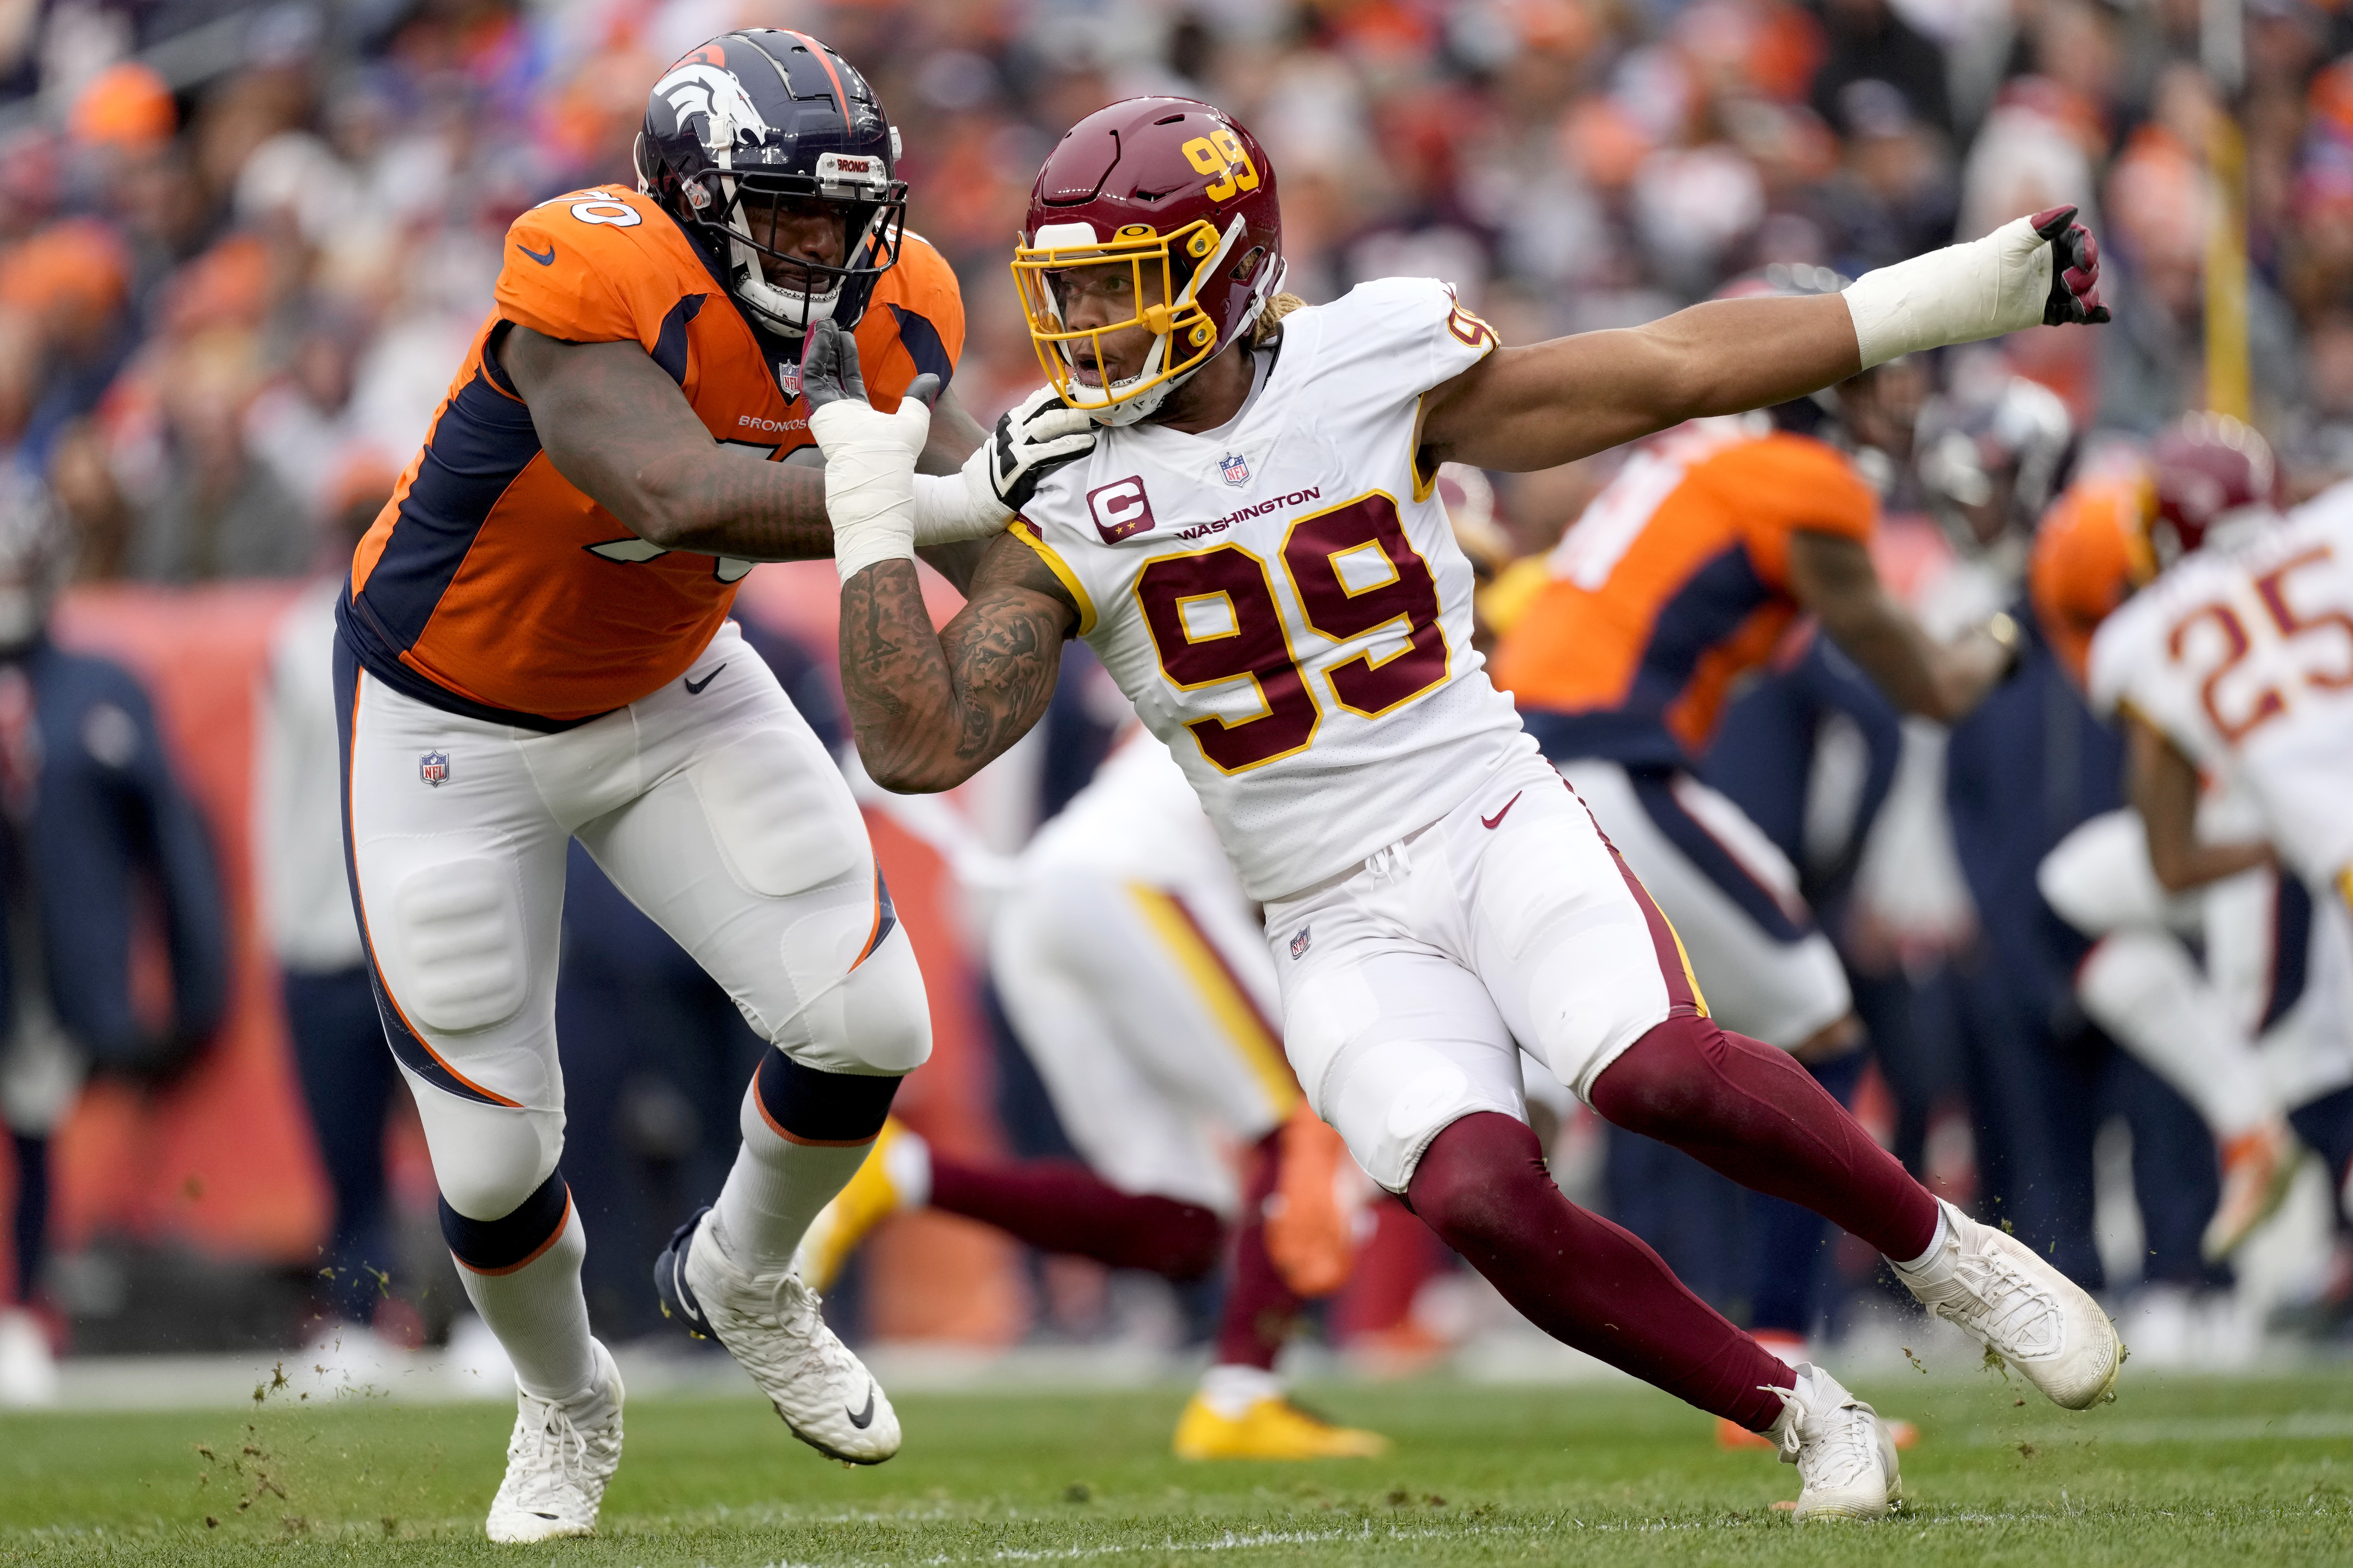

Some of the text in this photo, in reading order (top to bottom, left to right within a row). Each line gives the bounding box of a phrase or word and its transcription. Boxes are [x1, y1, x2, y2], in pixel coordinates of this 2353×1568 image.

[837, 159, 870, 173] BRONCOS
[1182, 130, 1259, 202] 99
[738, 415, 806, 432] BRONCOS
[1225, 465, 1248, 481] NFL
[1092, 481, 1145, 523] C
[1174, 486, 1321, 540] WASHINGTON
[1131, 488, 1451, 776] 99
[2166, 543, 2353, 750] 25
[424, 765, 445, 780] NFL
[1293, 936, 1308, 955] NFL
